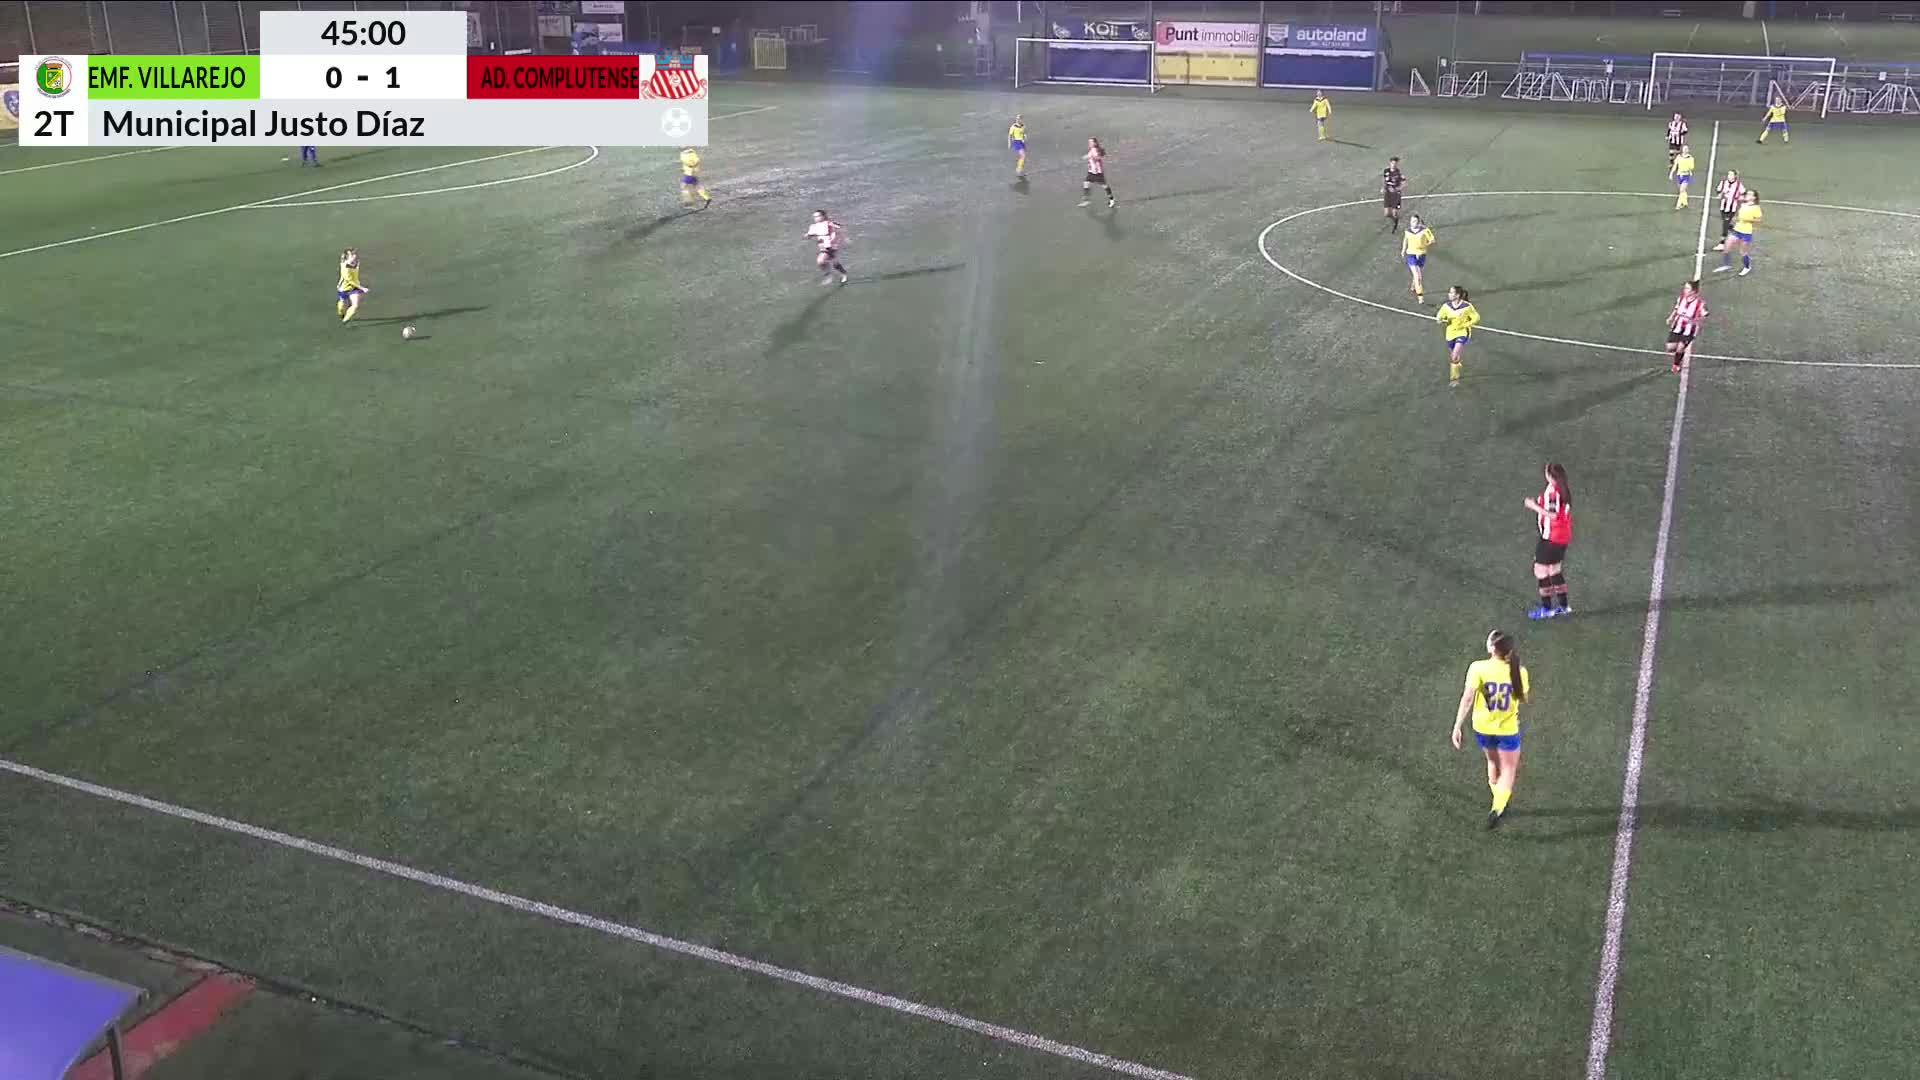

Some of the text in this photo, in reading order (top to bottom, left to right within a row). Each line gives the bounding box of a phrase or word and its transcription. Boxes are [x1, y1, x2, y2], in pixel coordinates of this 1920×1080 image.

[1165, 27, 1199, 41] Punt
[1296, 27, 1368, 42] autoland
[1484, 681, 1513, 712] 23
